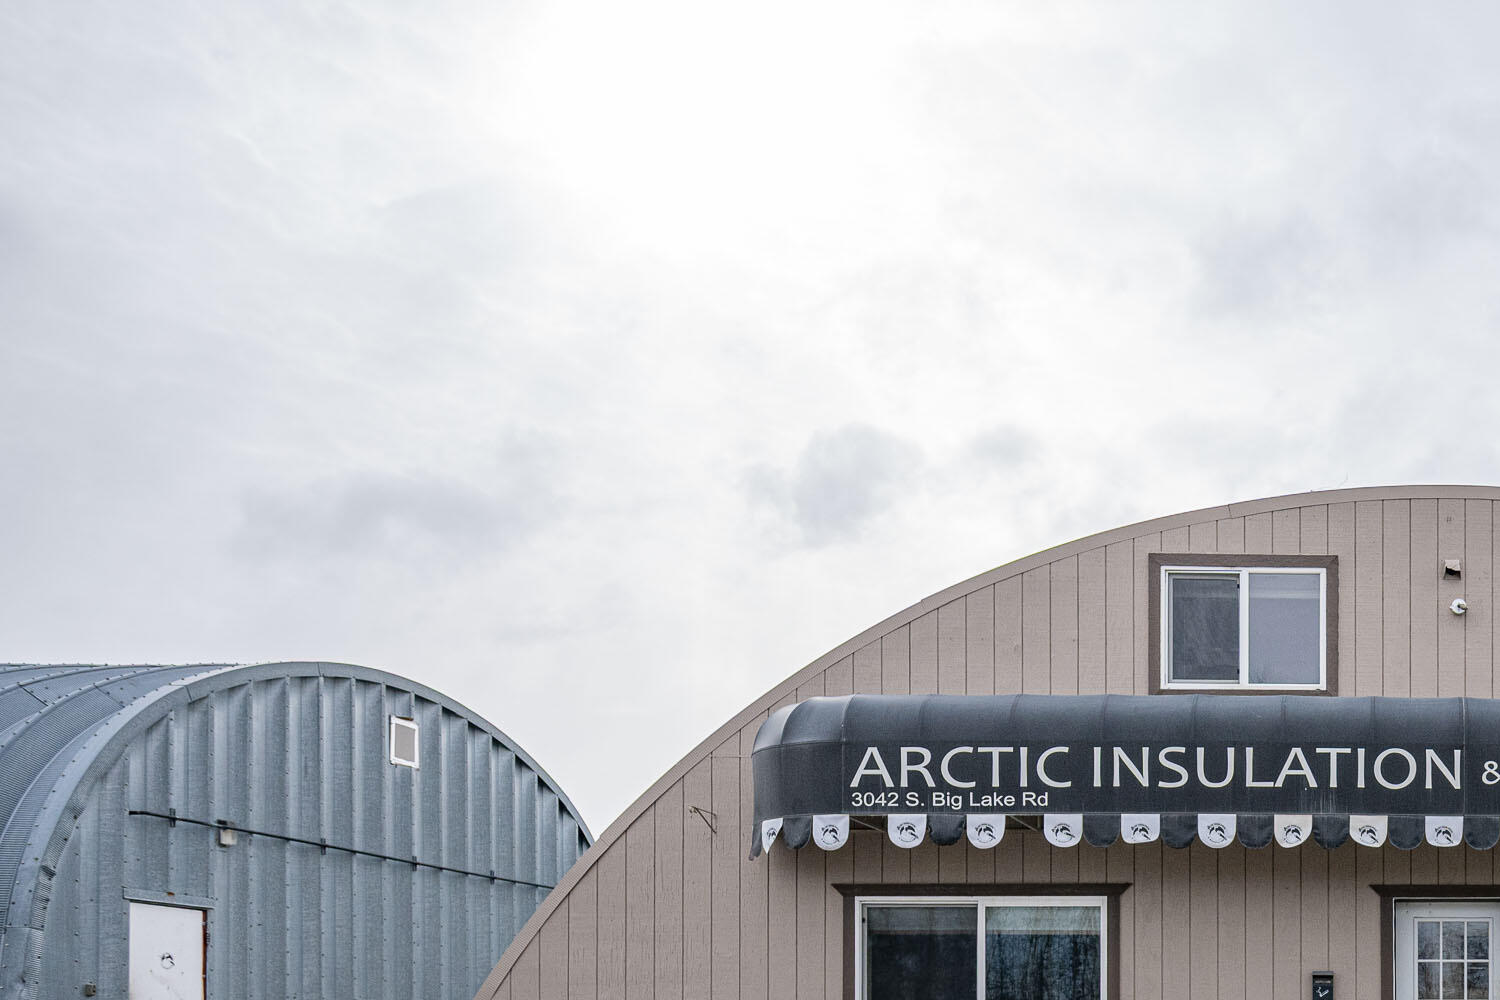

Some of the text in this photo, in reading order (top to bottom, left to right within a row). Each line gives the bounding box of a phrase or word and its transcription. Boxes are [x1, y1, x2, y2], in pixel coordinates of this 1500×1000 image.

[849, 746, 1072, 788] ARCTIC
[1093, 746, 1461, 790] INSULATION
[851, 791, 1049, 810] 3042 S. Big Lake Rd
